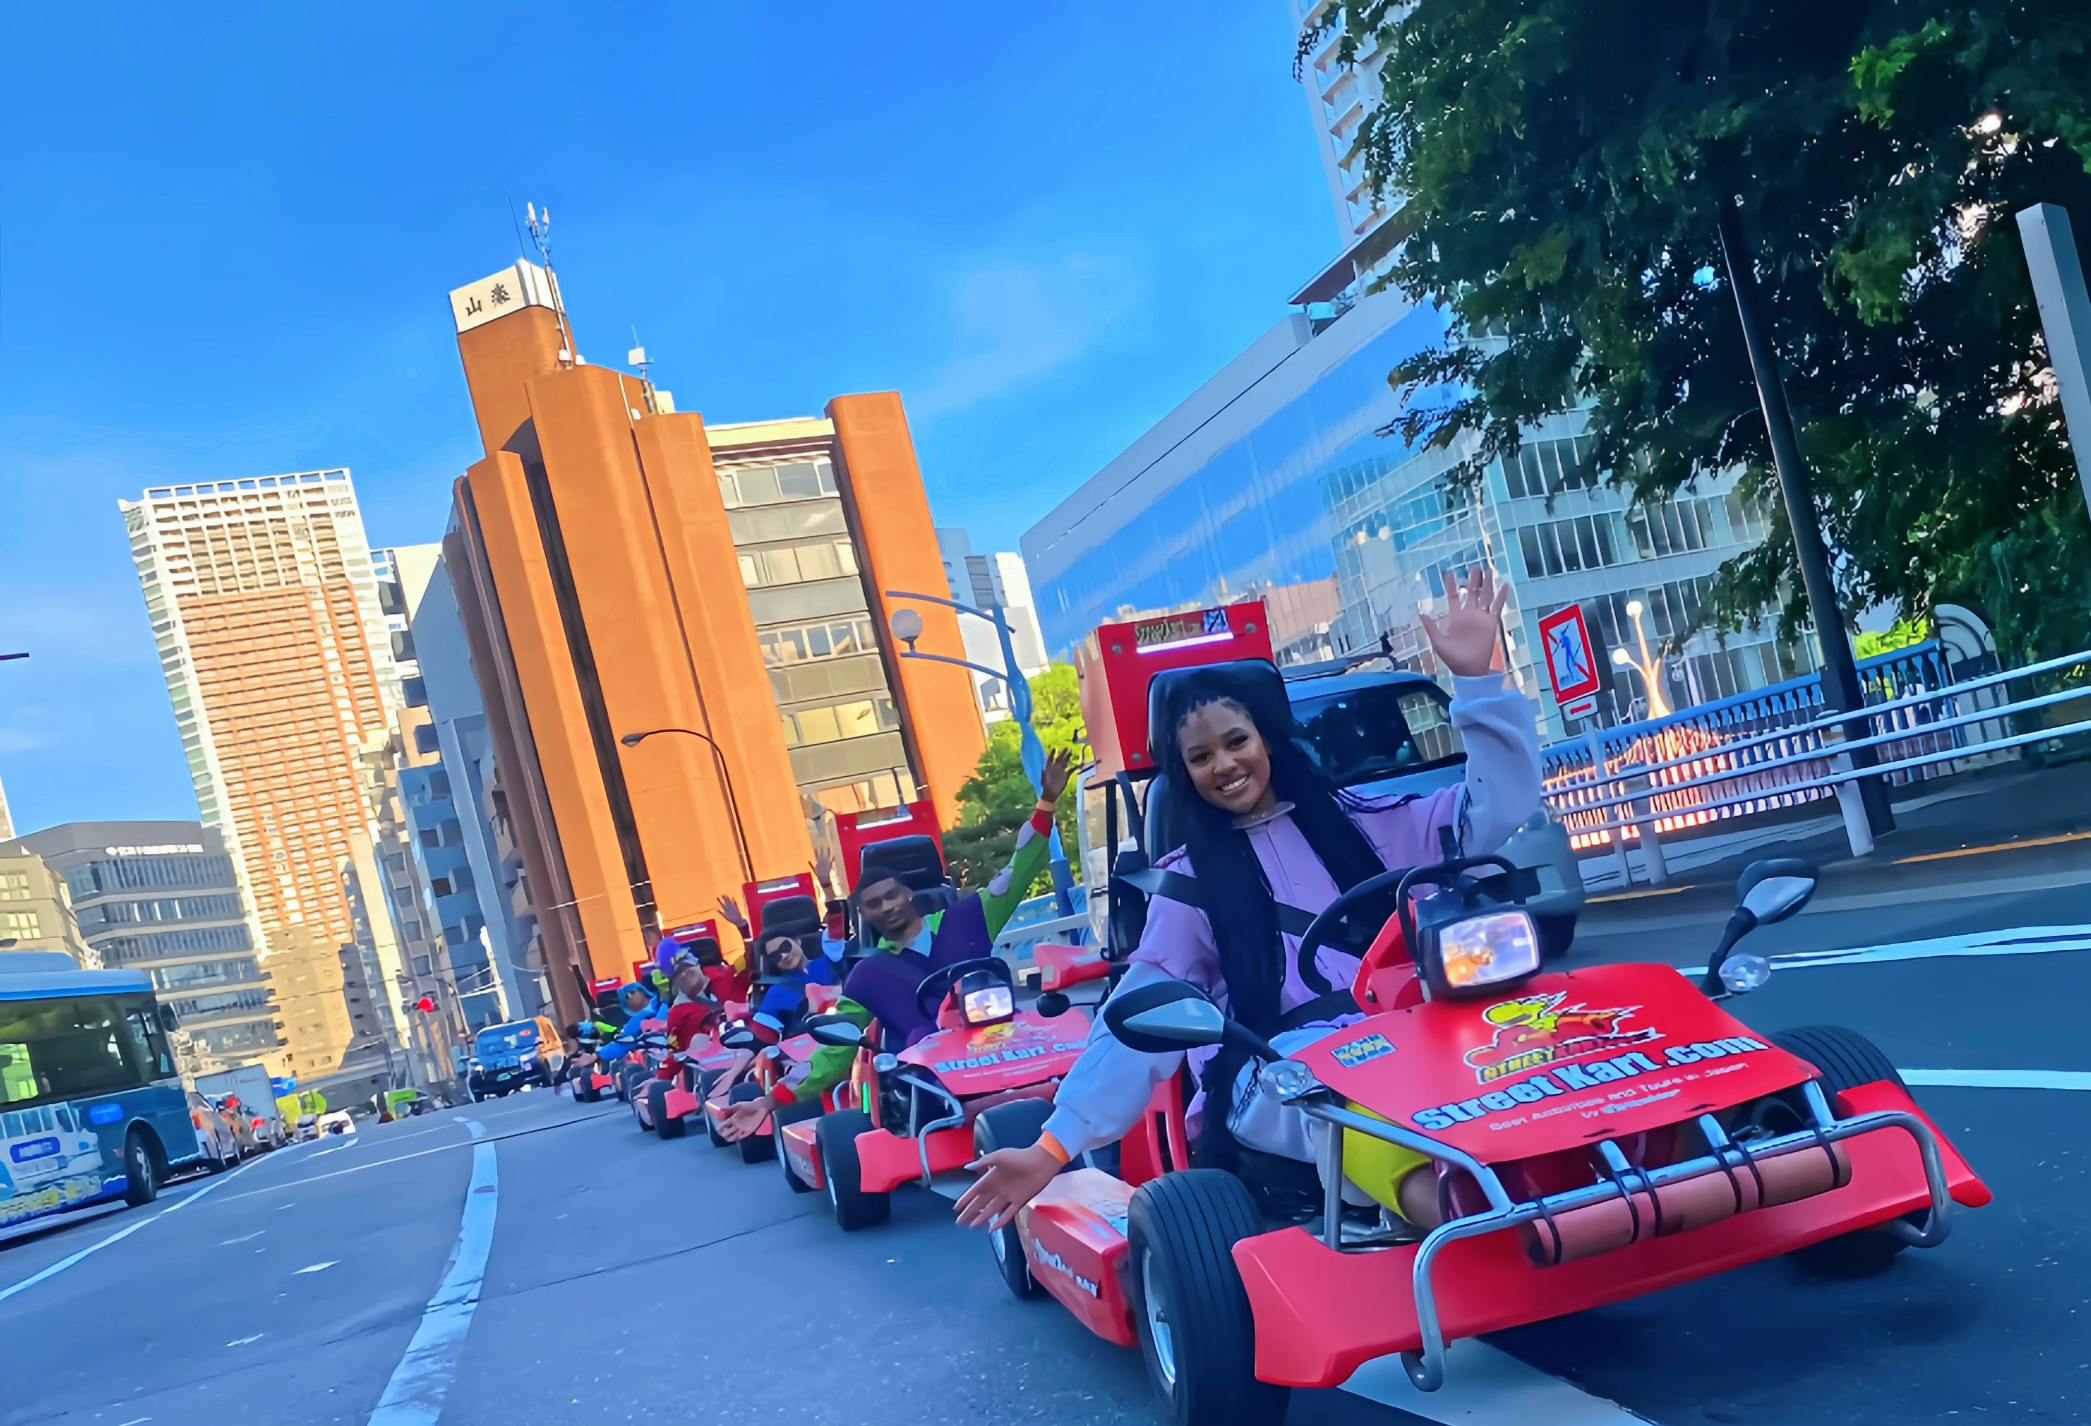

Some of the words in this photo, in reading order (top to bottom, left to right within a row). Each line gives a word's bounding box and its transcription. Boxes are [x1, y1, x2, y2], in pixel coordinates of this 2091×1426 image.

[1411, 1075, 1564, 1131] Street
[1550, 1052, 1663, 1091] Kart
[1664, 1036, 1770, 1067] .com
